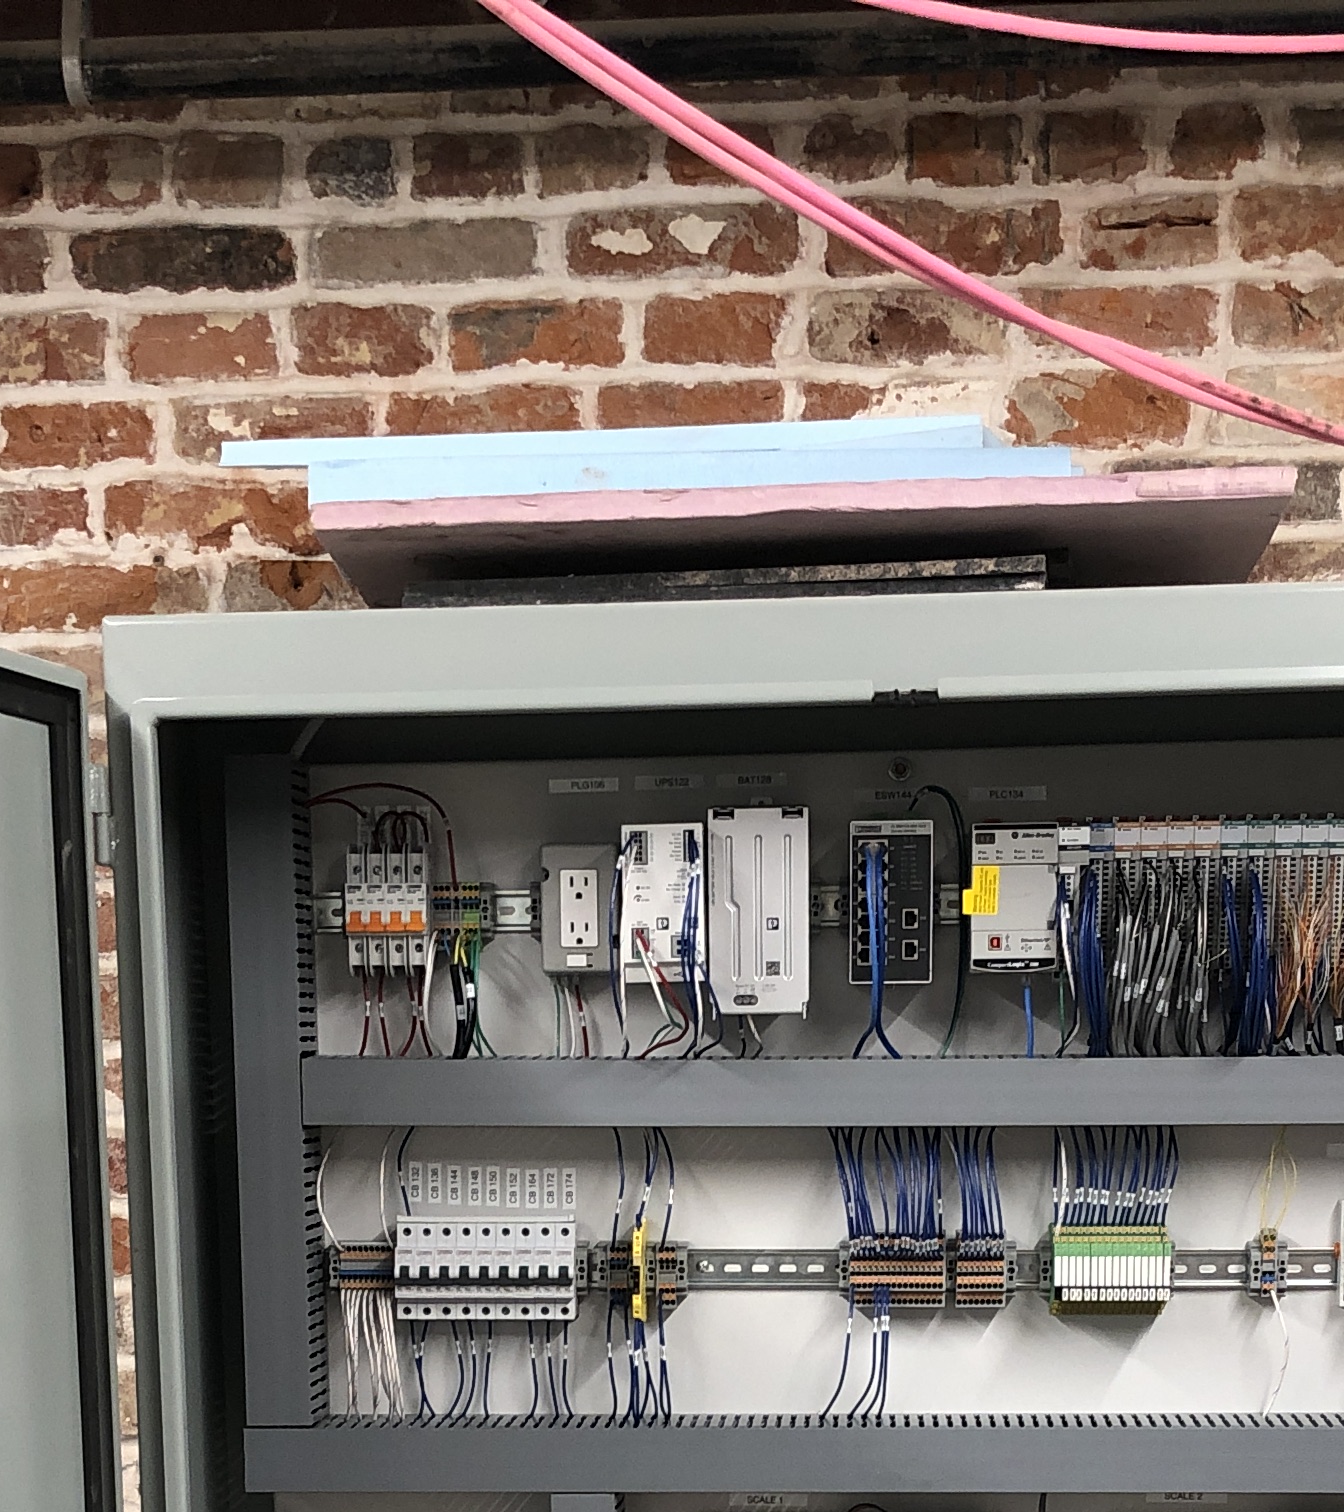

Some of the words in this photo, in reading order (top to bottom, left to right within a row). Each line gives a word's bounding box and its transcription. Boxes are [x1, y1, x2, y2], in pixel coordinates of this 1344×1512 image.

[655, 778, 689, 787] UPS122
[990, 790, 1023, 798] PLC134
[471, 1170, 479, 1186] 148
[489, 1171, 497, 1186] 150
[509, 1173, 517, 1188] 152
[528, 1174, 536, 1189] 164
[411, 1185, 419, 1198] CB
[431, 1186, 438, 1198] CB
[451, 1187, 458, 1200] CB
[471, 1189, 478, 1201] CB
[489, 1189, 497, 1202] CB
[509, 1191, 517, 1203] CB
[529, 1191, 536, 1204] CB
[547, 1191, 554, 1203] CB
[566, 1191, 573, 1204] CB
[747, 1496, 776, 1504] SCALE
[779, 1496, 783, 1504] 1
